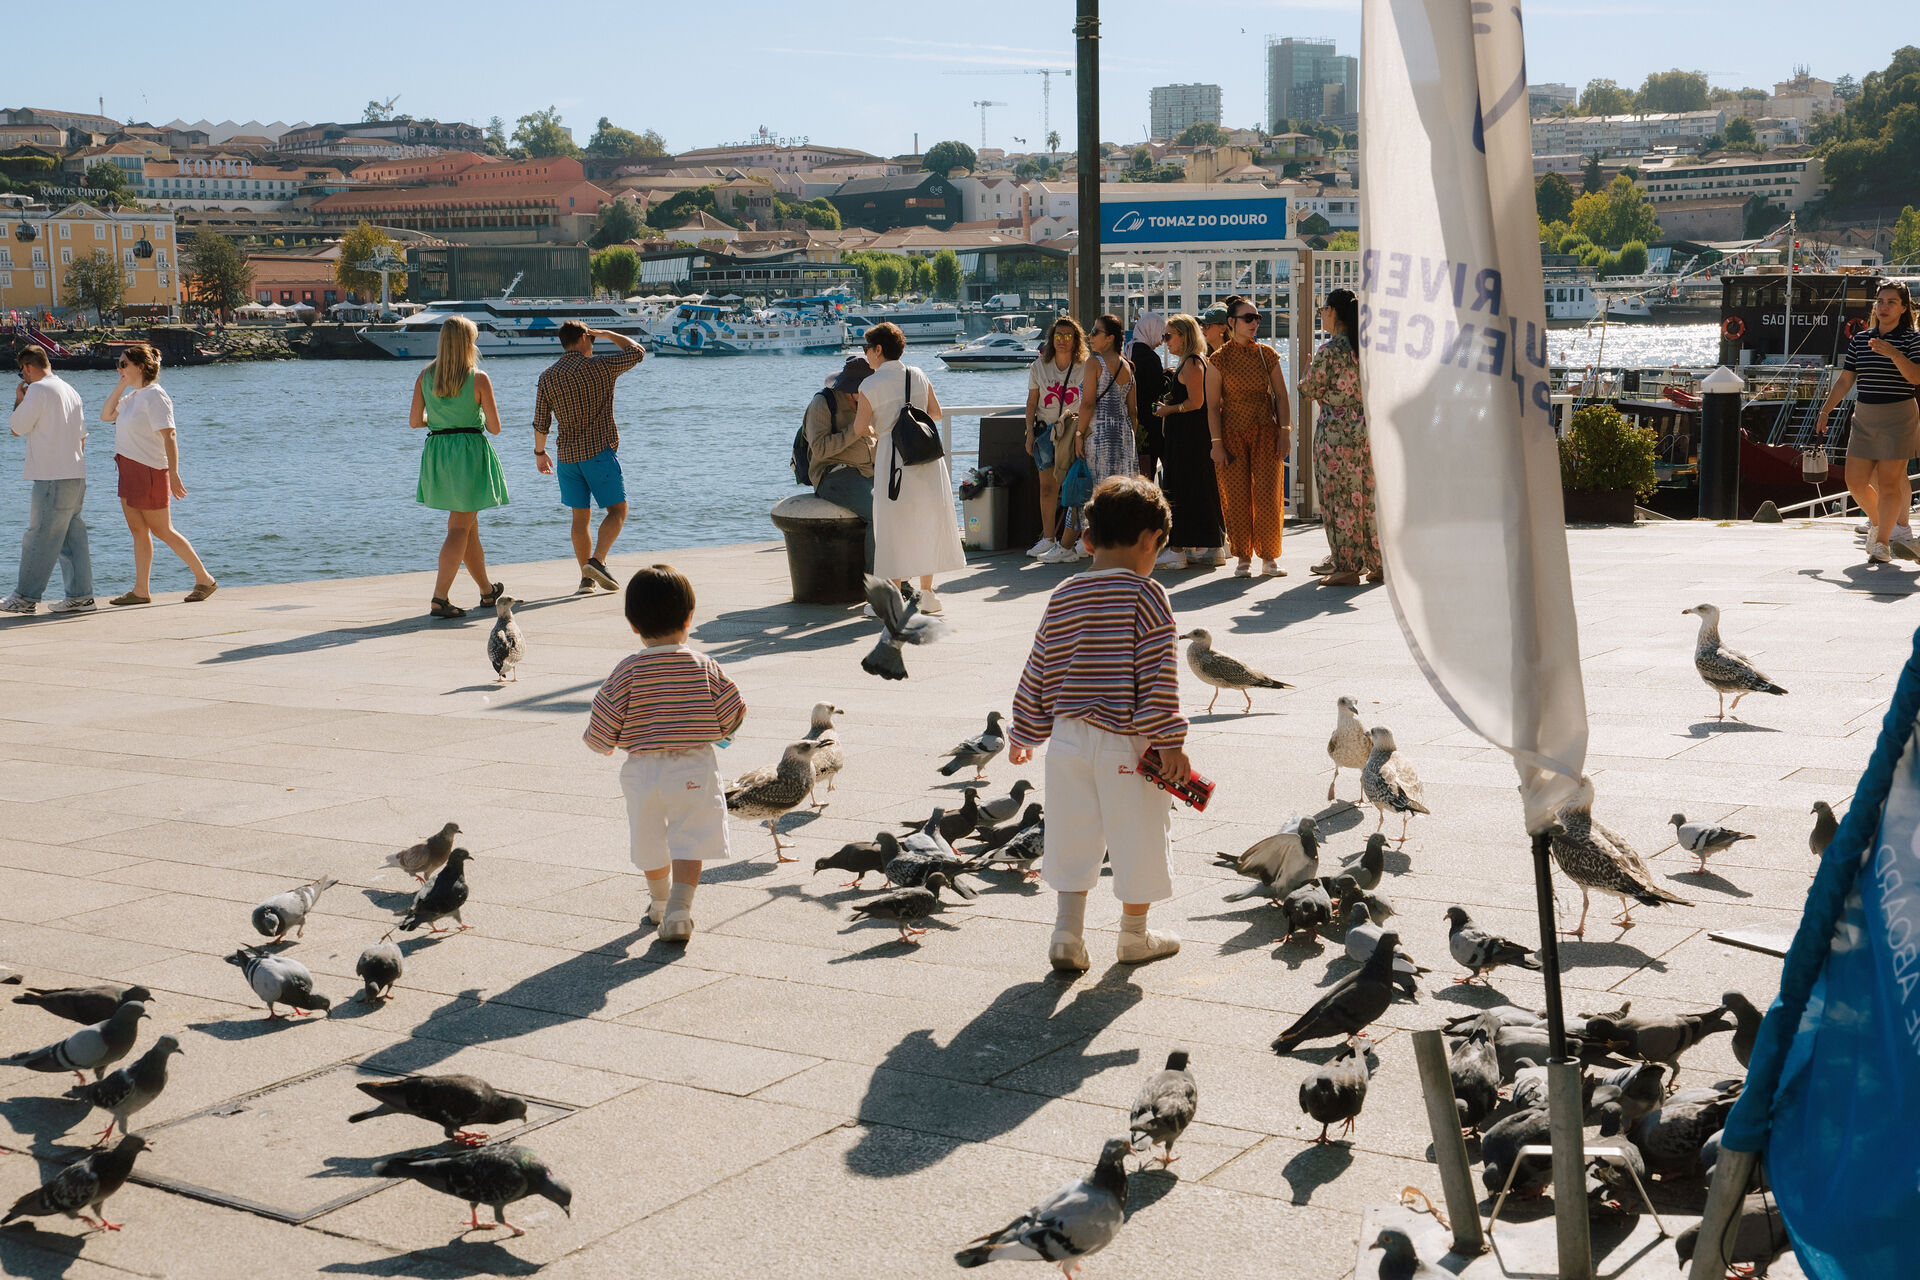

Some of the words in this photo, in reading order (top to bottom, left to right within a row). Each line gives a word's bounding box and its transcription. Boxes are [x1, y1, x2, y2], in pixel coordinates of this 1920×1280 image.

[409, 127, 482, 140] BARROS
[176, 158, 252, 176] KOPKE
[40, 185, 75, 197] RAMOS
[78, 187, 108, 197] PINTO
[1148, 215, 1195, 227] TOMAZ
[1199, 214, 1217, 226] DO
[1220, 213, 1268, 225] DOURO
[1790, 314, 1829, 326] TELMO
